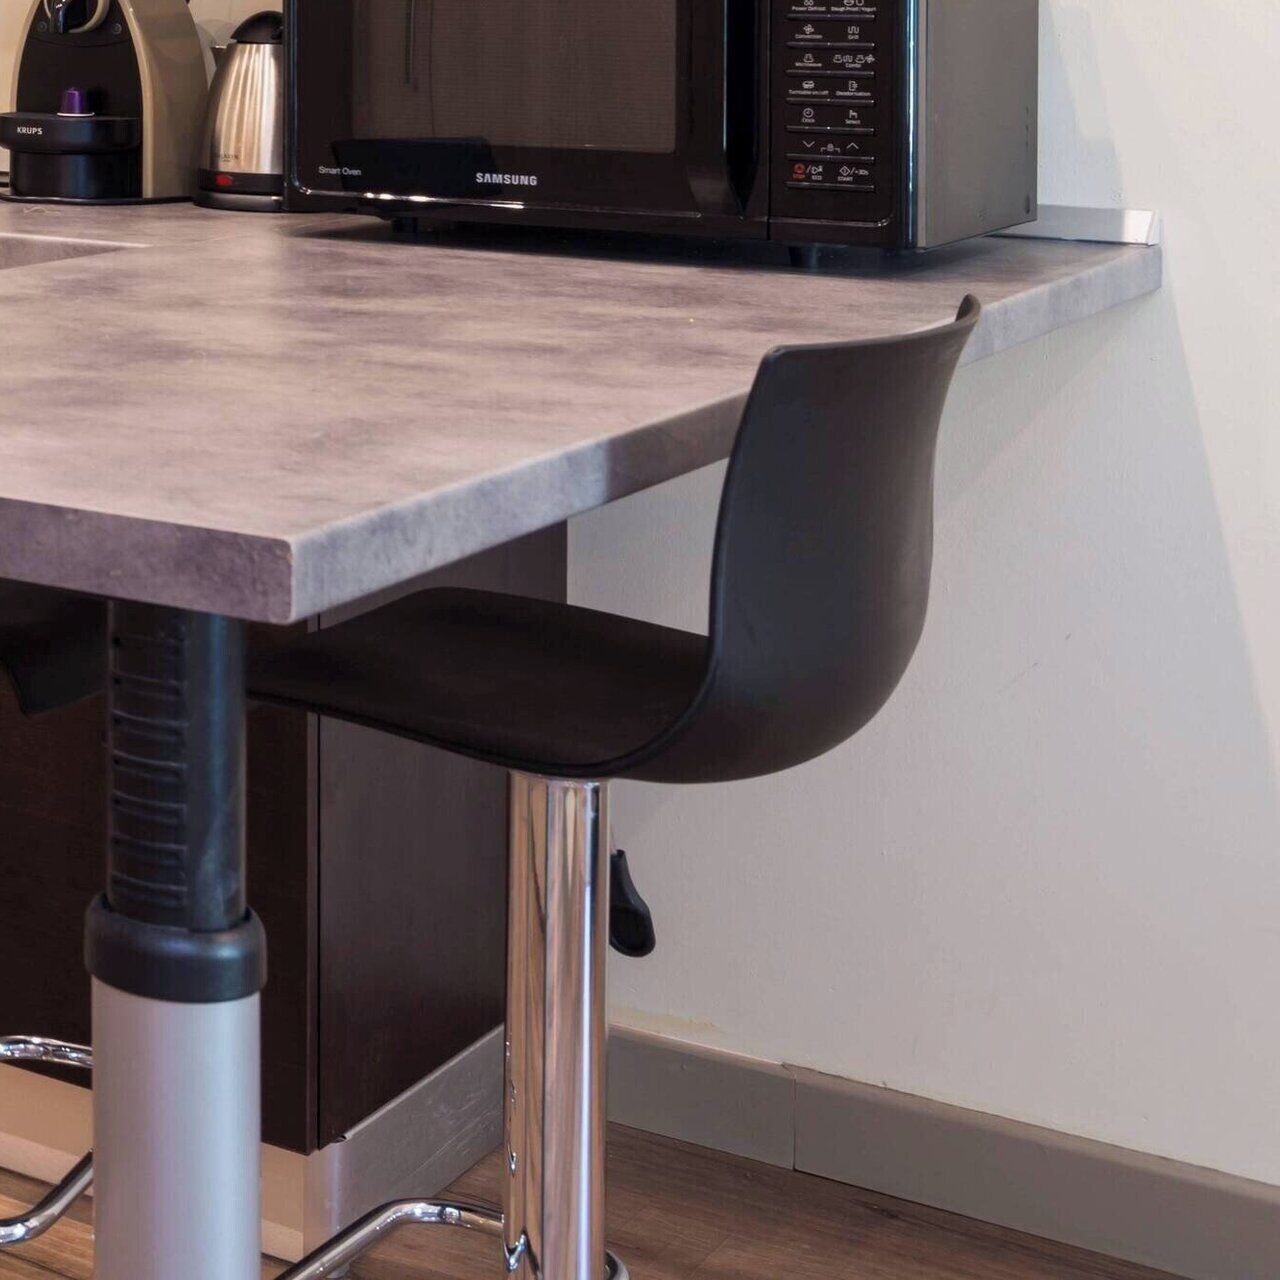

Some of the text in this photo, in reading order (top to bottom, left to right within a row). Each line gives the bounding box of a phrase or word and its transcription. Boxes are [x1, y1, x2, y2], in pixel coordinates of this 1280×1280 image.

[17, 126, 43, 135] KRUPS
[318, 165, 362, 176] Smart Oven
[476, 172, 538, 186] SAMSUNG
